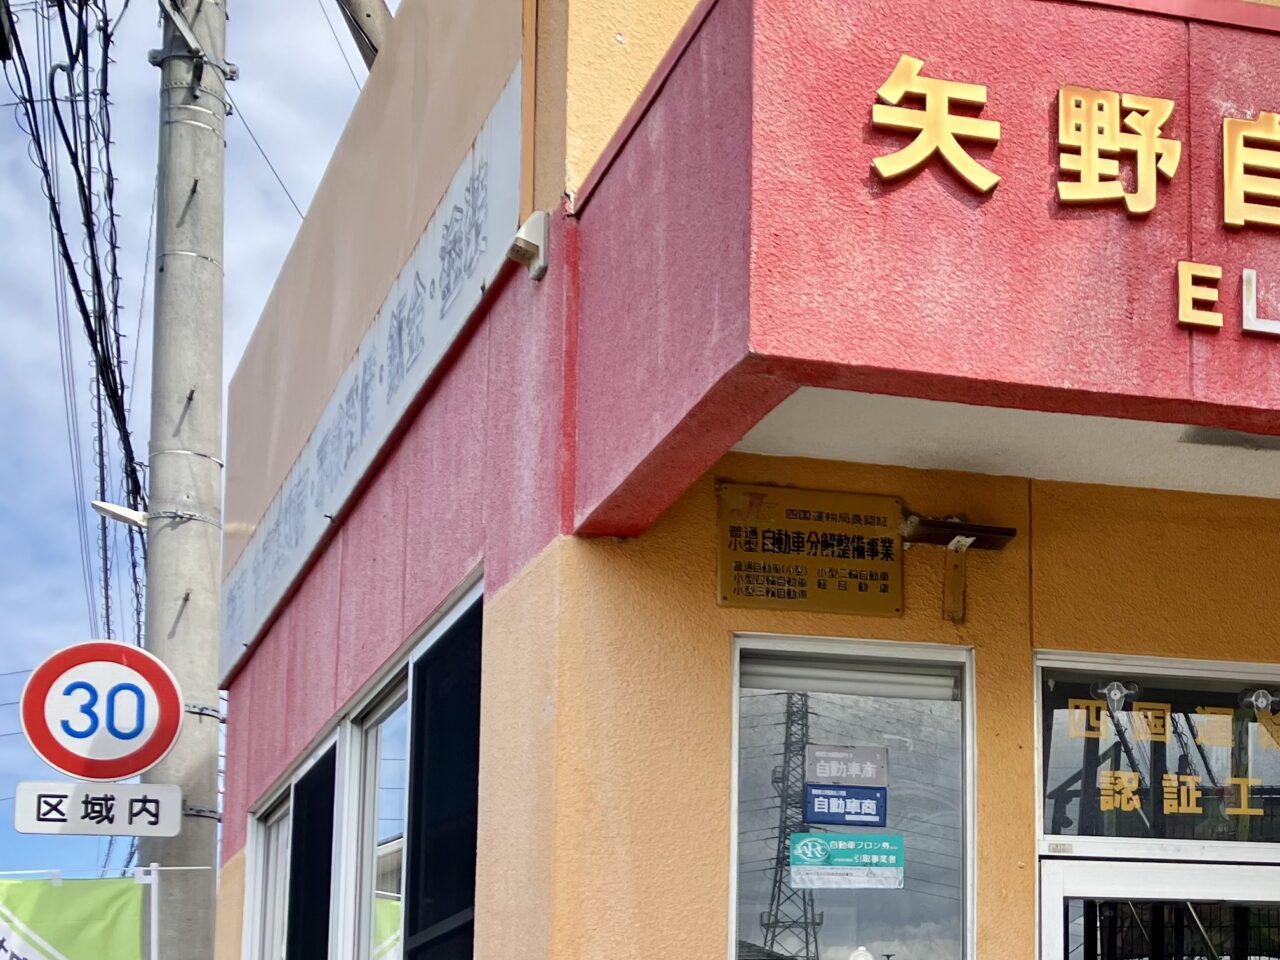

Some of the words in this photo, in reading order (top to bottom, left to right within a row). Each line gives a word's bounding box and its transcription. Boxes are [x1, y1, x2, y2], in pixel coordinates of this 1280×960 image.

[60, 681, 146, 741] 30
[36, 793, 161, 826] 区域内
